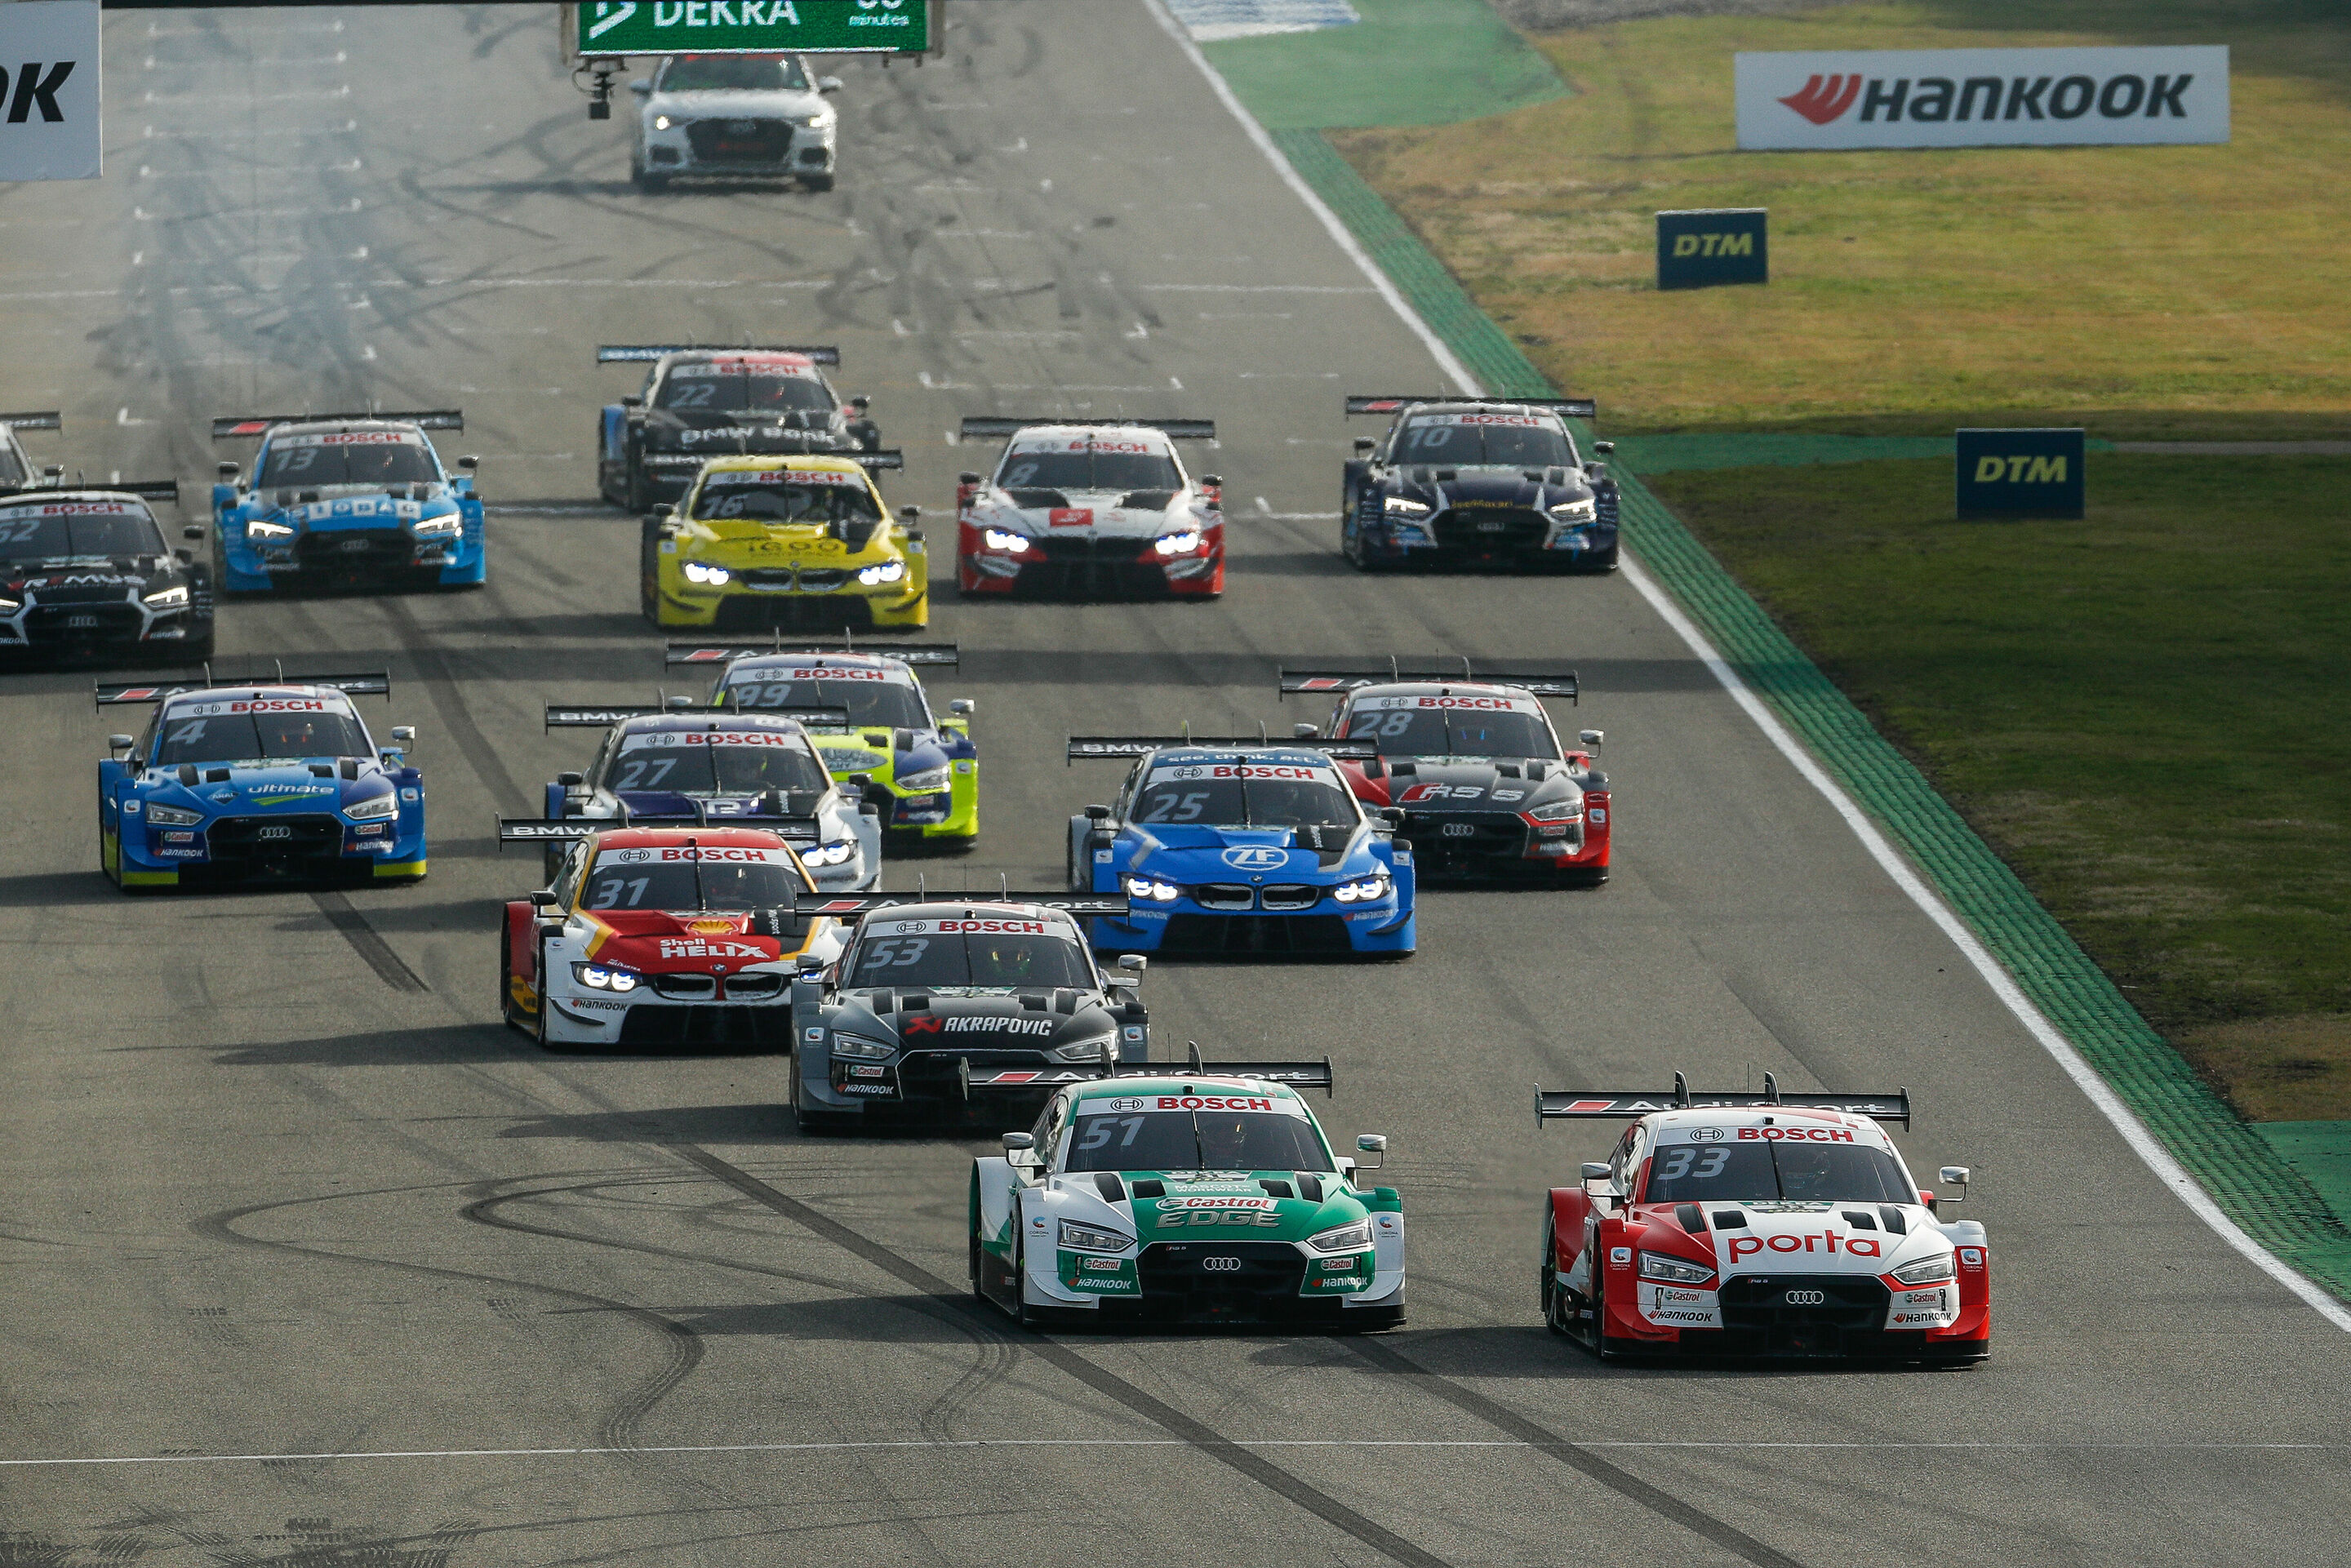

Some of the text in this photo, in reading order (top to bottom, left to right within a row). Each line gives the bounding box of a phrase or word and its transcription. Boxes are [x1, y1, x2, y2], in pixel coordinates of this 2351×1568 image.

[654, 0, 800, 25] DEKRA
[1673, 233, 1753, 257] DTM
[669, 384, 716, 408] 22
[1460, 415, 1539, 426] BOSCH
[323, 432, 402, 444] BOSCH
[1407, 426, 1453, 449] 10
[1069, 441, 1148, 453] BOSCH
[275, 448, 318, 472] 13
[1975, 455, 2067, 483] DTM
[760, 472, 843, 483] BOSCH
[43, 504, 124, 514] BOSCH
[793, 668, 884, 681] BOSCH
[739, 683, 792, 707] 99
[231, 700, 323, 713] BOSCH
[1418, 696, 1513, 710] BOSCH
[559, 712, 639, 722] BMW
[1351, 711, 1415, 735] 28
[167, 718, 208, 744] 4
[686, 733, 784, 746] BOSCH
[1082, 743, 1163, 753] BMW
[616, 757, 678, 788] 27
[1214, 766, 1314, 780] BOSCH
[248, 784, 336, 794] ultimate
[1144, 792, 1211, 823] 25
[512, 825, 596, 836] BMW
[662, 848, 767, 862] BOSCH
[1231, 849, 1278, 866] ZF
[589, 877, 651, 910] 31
[939, 920, 1044, 934] BOSCH
[660, 938, 706, 947] Shell
[661, 941, 771, 960] HELIX
[862, 938, 931, 969] 53
[1157, 1097, 1272, 1112] BOSCH
[1078, 1117, 1145, 1151] 51
[1737, 1126, 1855, 1143] BOSCH
[1656, 1148, 1731, 1180] 33
[1186, 1197, 1270, 1210] Castrol
[1155, 1210, 1284, 1228] EDGE
[1727, 1229, 1882, 1264] porta
[1091, 1259, 1119, 1270] Castrol
[1329, 1259, 1353, 1269] Castrol
[1673, 1291, 1701, 1302] Castrol
[1913, 1293, 1937, 1304] Castrol
